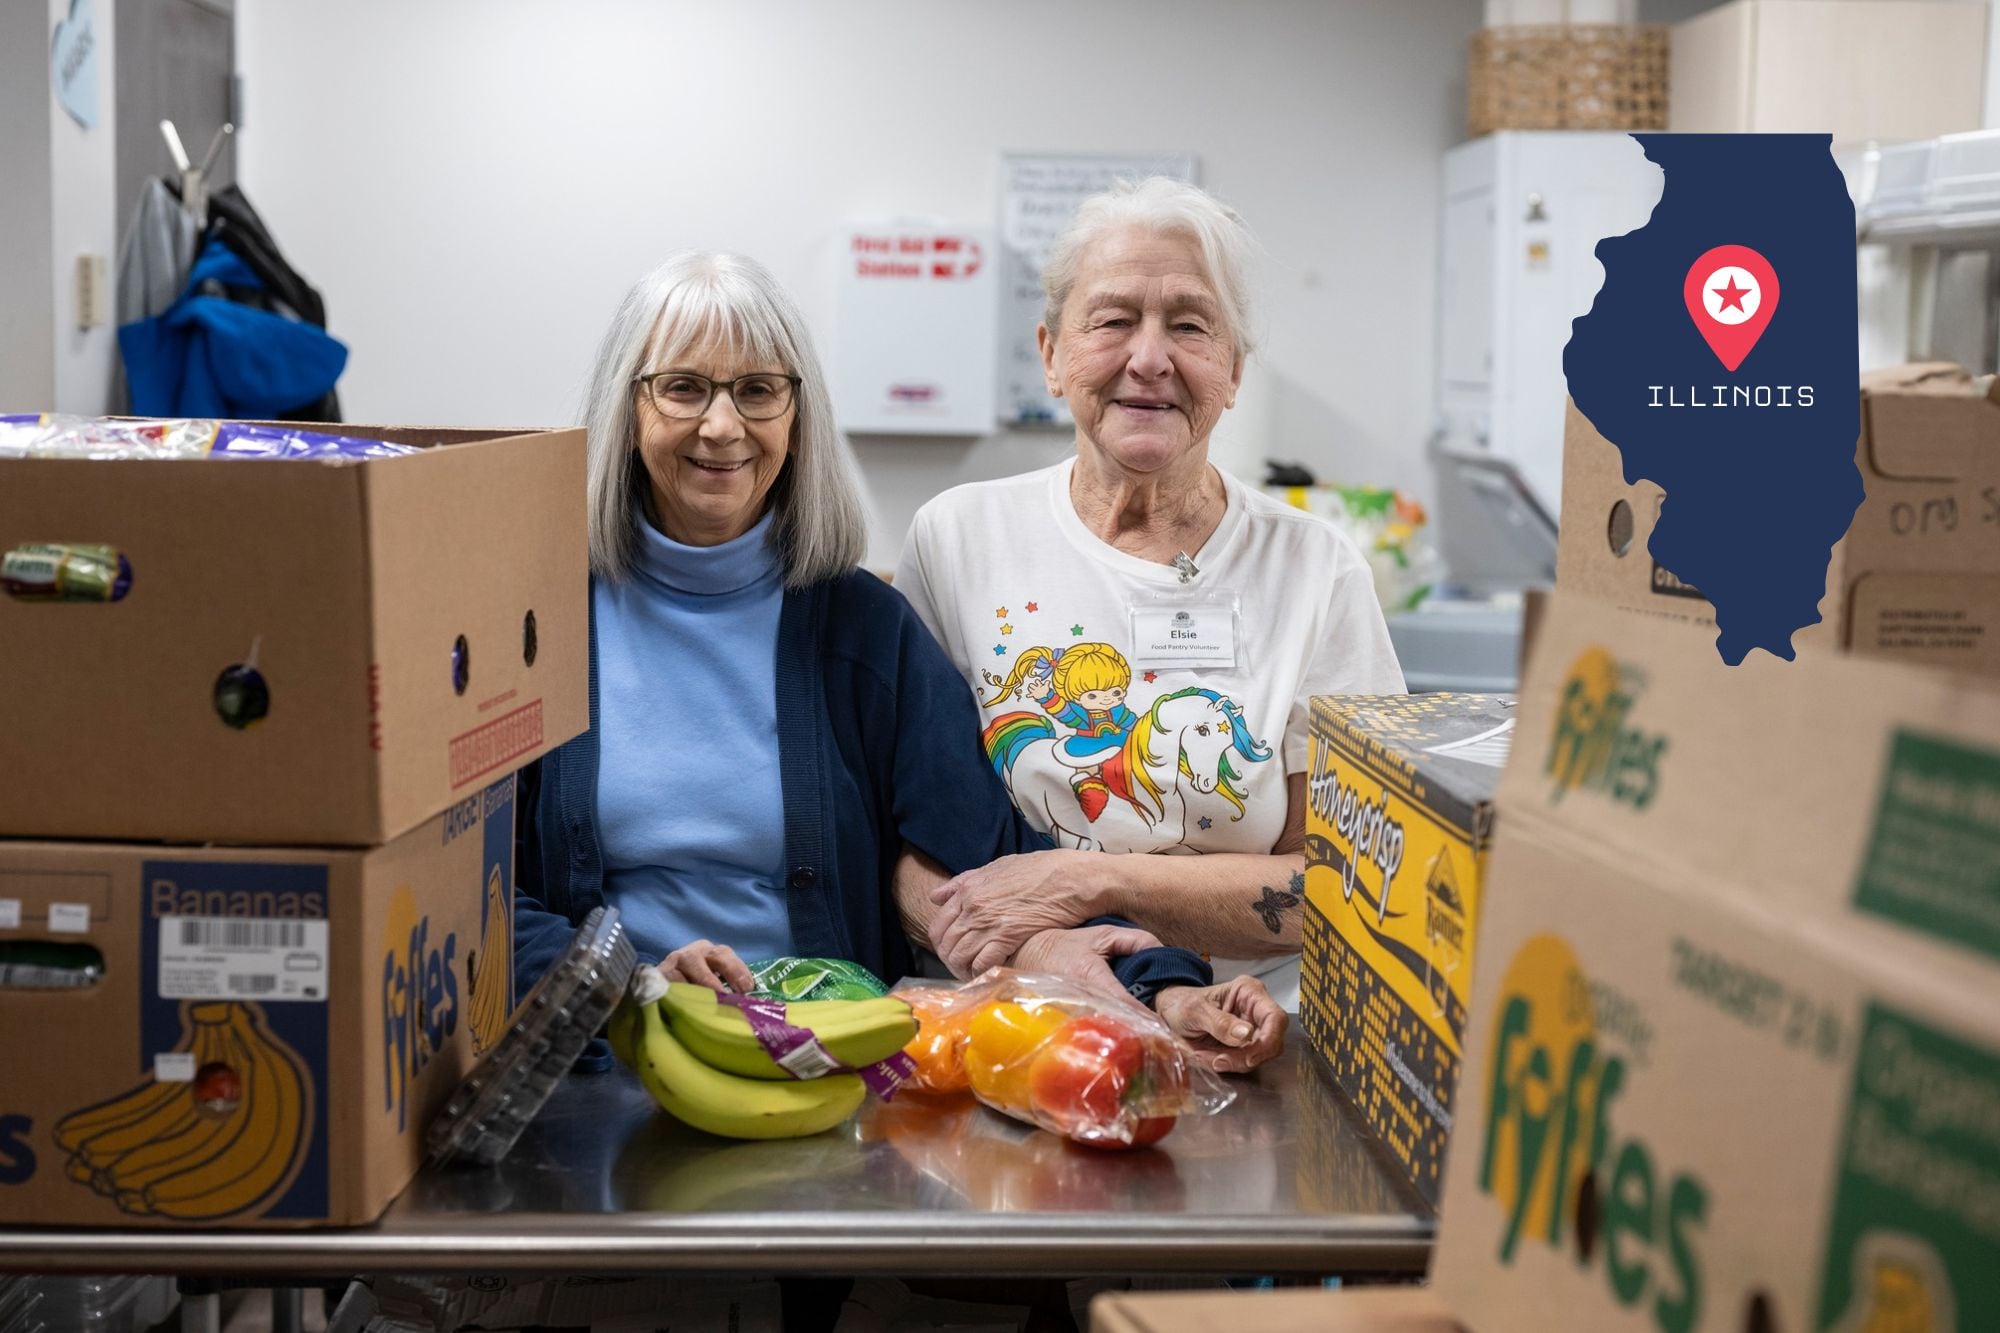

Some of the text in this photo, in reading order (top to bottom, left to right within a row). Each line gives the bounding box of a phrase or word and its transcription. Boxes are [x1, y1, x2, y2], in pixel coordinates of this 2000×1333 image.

[1171, 630, 1197, 639] Elsie
[1310, 737, 1404, 922] Honeycrisp
[152, 879, 322, 919] Bananas
